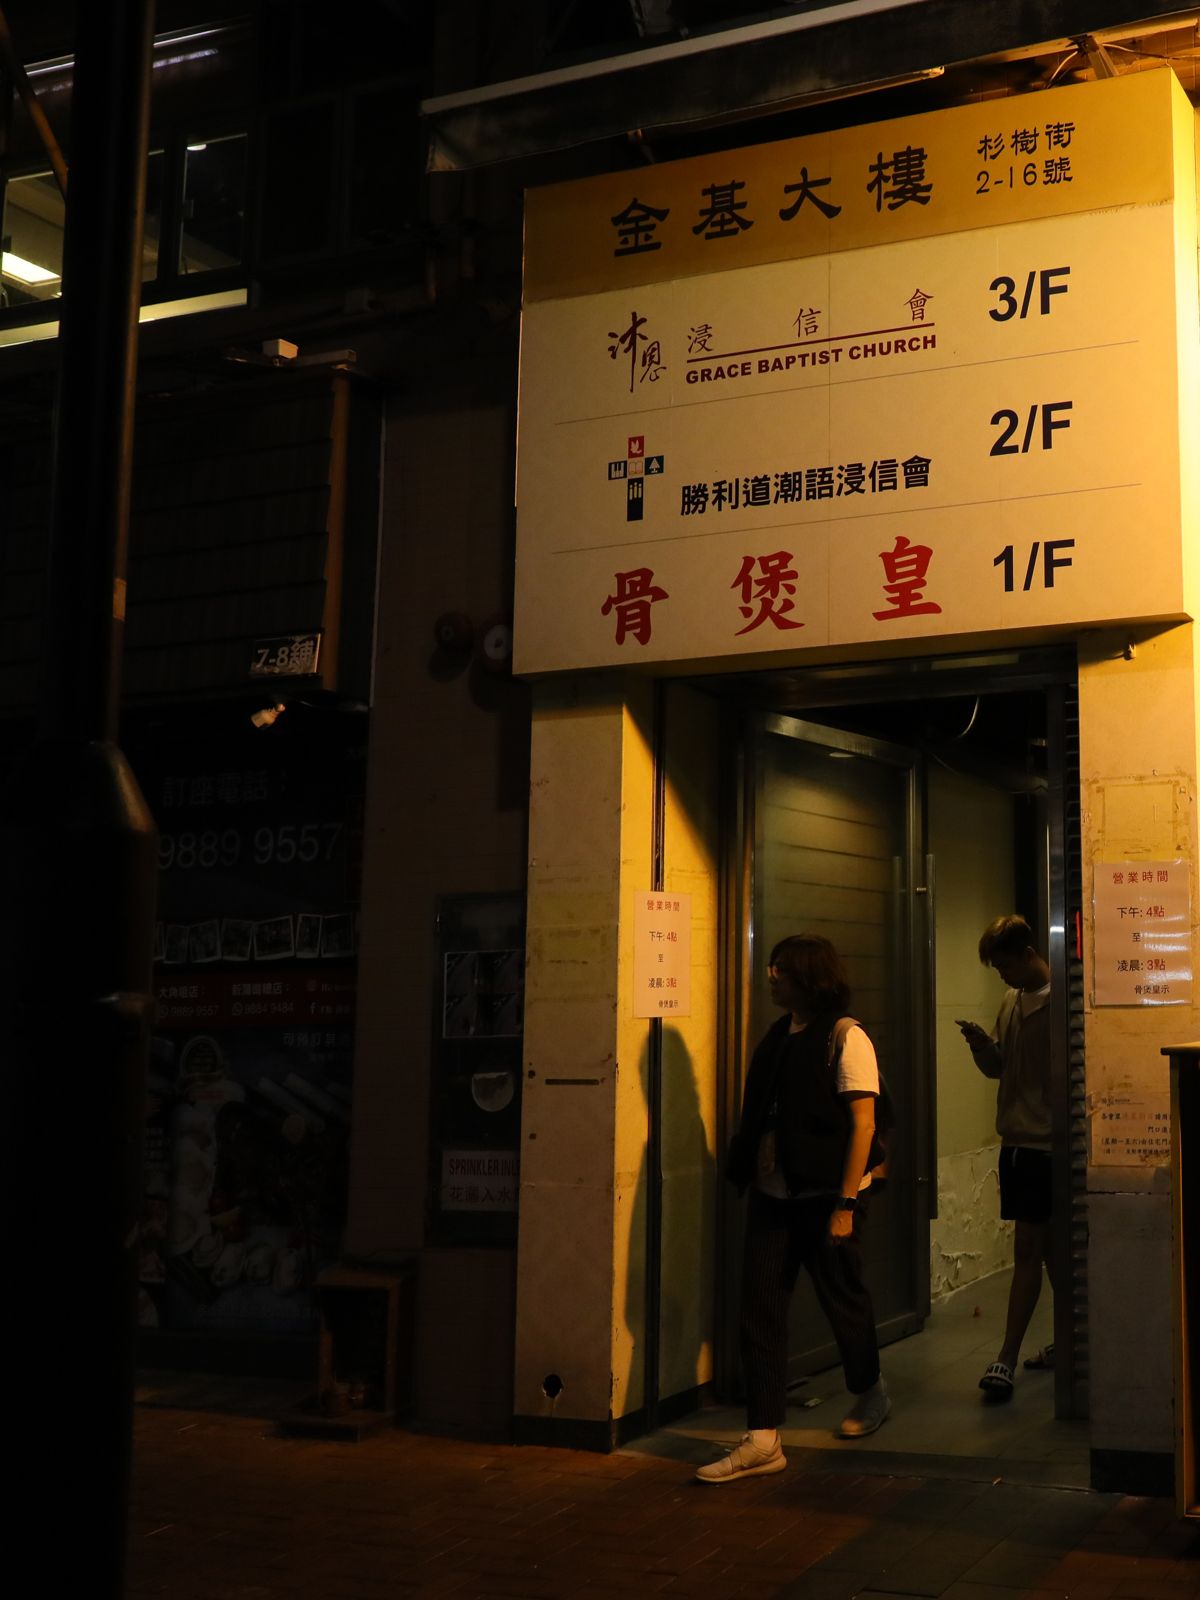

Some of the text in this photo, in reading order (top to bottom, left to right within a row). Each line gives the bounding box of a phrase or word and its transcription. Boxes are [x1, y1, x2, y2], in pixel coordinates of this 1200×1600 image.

[977, 122, 1075, 162] 杉樹街
[976, 157, 1073, 194] 2-16號
[610, 145, 933, 257] 金基大樓
[989, 267, 1071, 322] 3/F
[687, 288, 934, 354] 浸信會
[685, 334, 937, 385] GRACE BAPTIST CHURCH
[990, 401, 1073, 457] 2/F
[680, 455, 932, 516] 勝利道潮語浸信會
[993, 539, 1075, 593] 1/F
[600, 536, 943, 646] 骨煲皇
[158, 822, 344, 870] 9889 9557
[1112, 870, 1169, 884] 營業時間
[646, 900, 680, 912] 營業時間
[1116, 905, 1165, 919] 下午: 4點
[1132, 932, 1141, 942] 至
[1117, 959, 1166, 972] 凌晨: 3點
[449, 1158, 499, 1176] SPRINKLER
